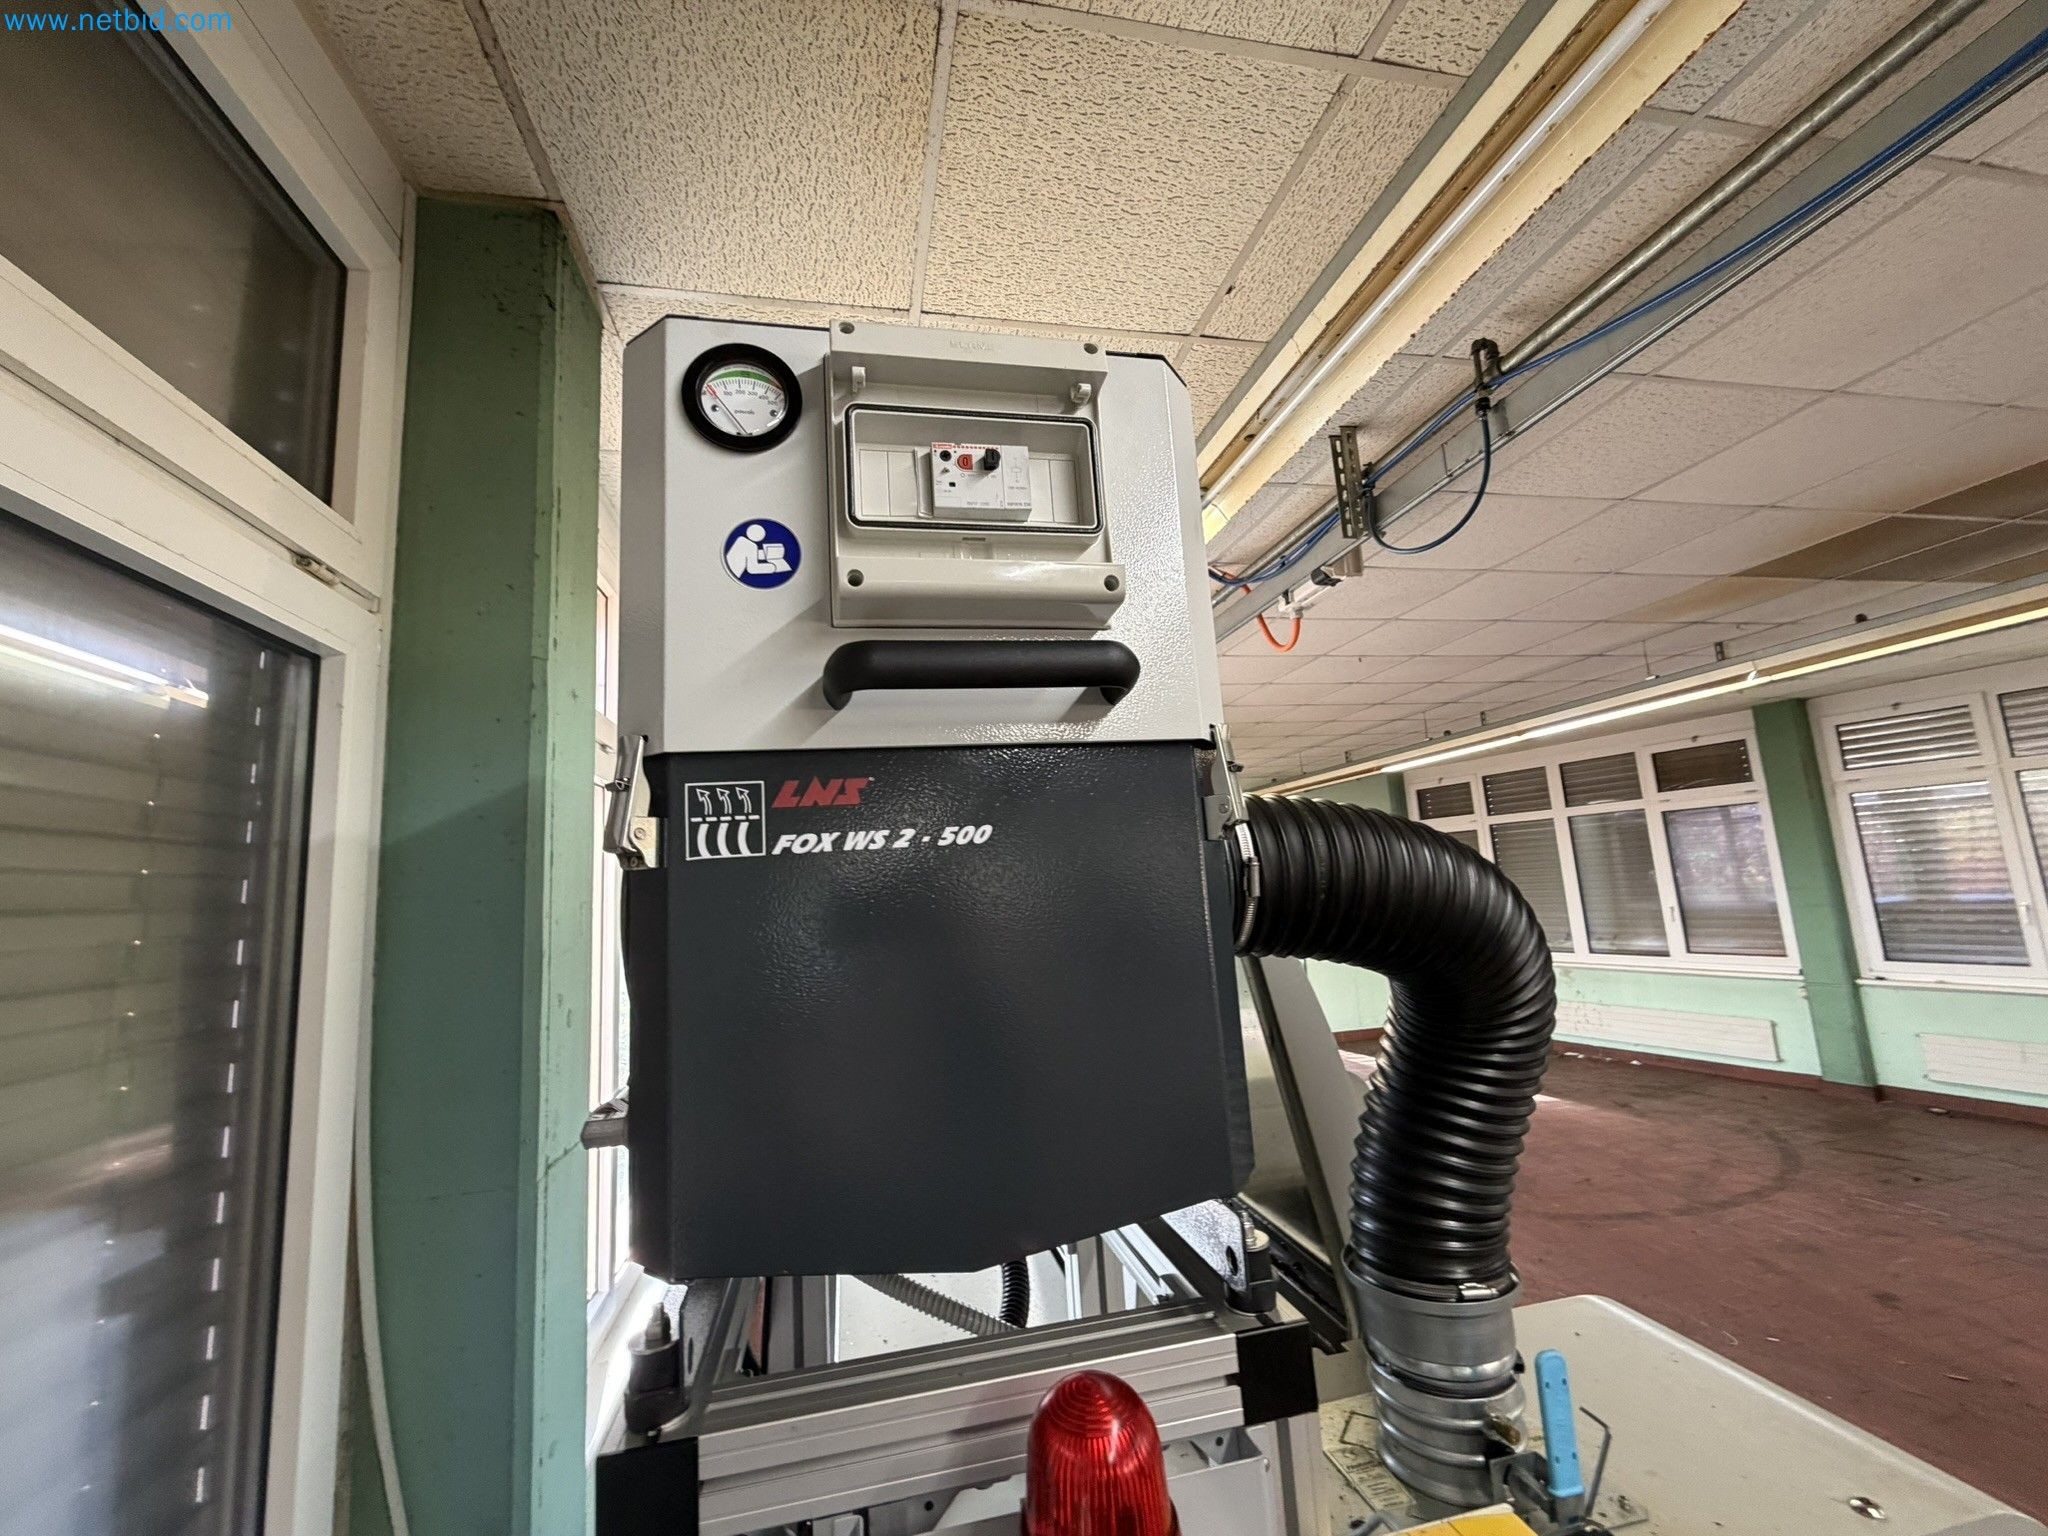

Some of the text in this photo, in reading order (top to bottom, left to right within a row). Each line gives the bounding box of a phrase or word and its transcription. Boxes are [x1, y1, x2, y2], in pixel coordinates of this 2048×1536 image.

[772, 777, 870, 808] LNS
[771, 831, 841, 855] FOX
[842, 829, 889, 852] WS
[892, 827, 915, 849] 2
[939, 824, 994, 847] 500
